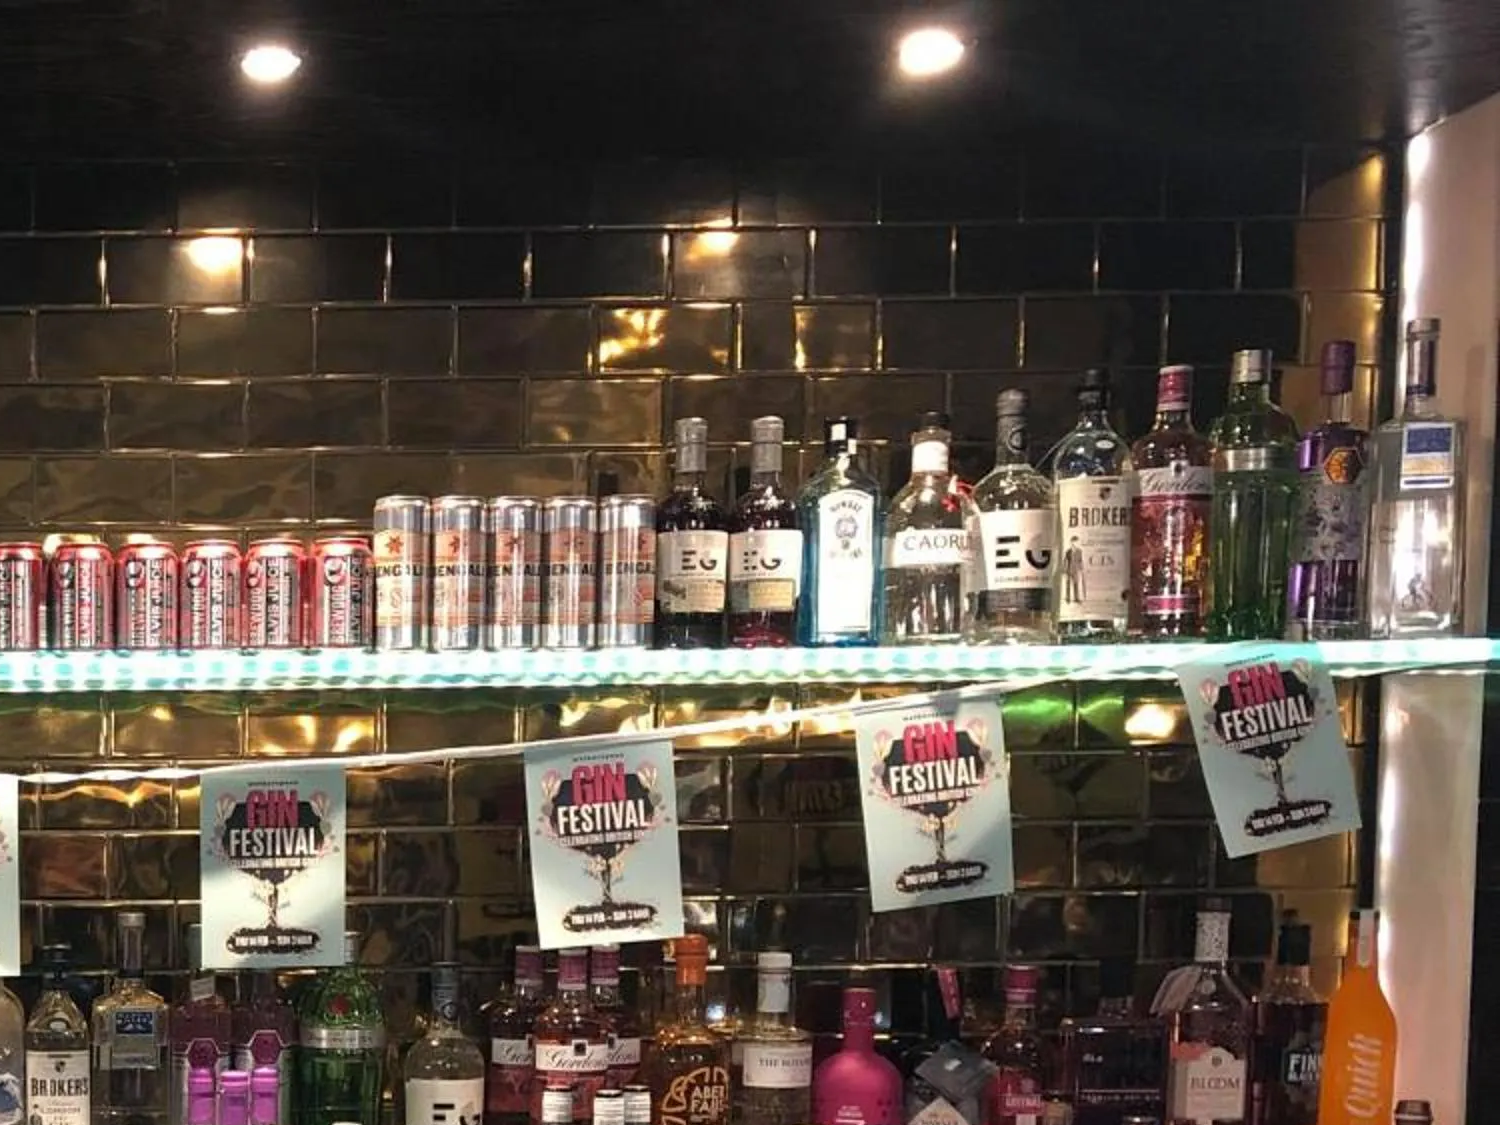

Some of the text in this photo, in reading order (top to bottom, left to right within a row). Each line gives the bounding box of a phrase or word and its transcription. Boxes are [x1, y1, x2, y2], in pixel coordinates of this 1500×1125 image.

[1228, 662, 1285, 708] GIN
[1220, 694, 1313, 740] FESTIVAL
[903, 719, 959, 763] GIN
[572, 762, 626, 803] GIN
[888, 756, 980, 795] FESTIVAL
[247, 790, 299, 828] GIN
[557, 800, 649, 835] FESTIVAL
[229, 827, 320, 857] FESTIVAL
[1190, 1077, 1241, 1090] BLOOM
